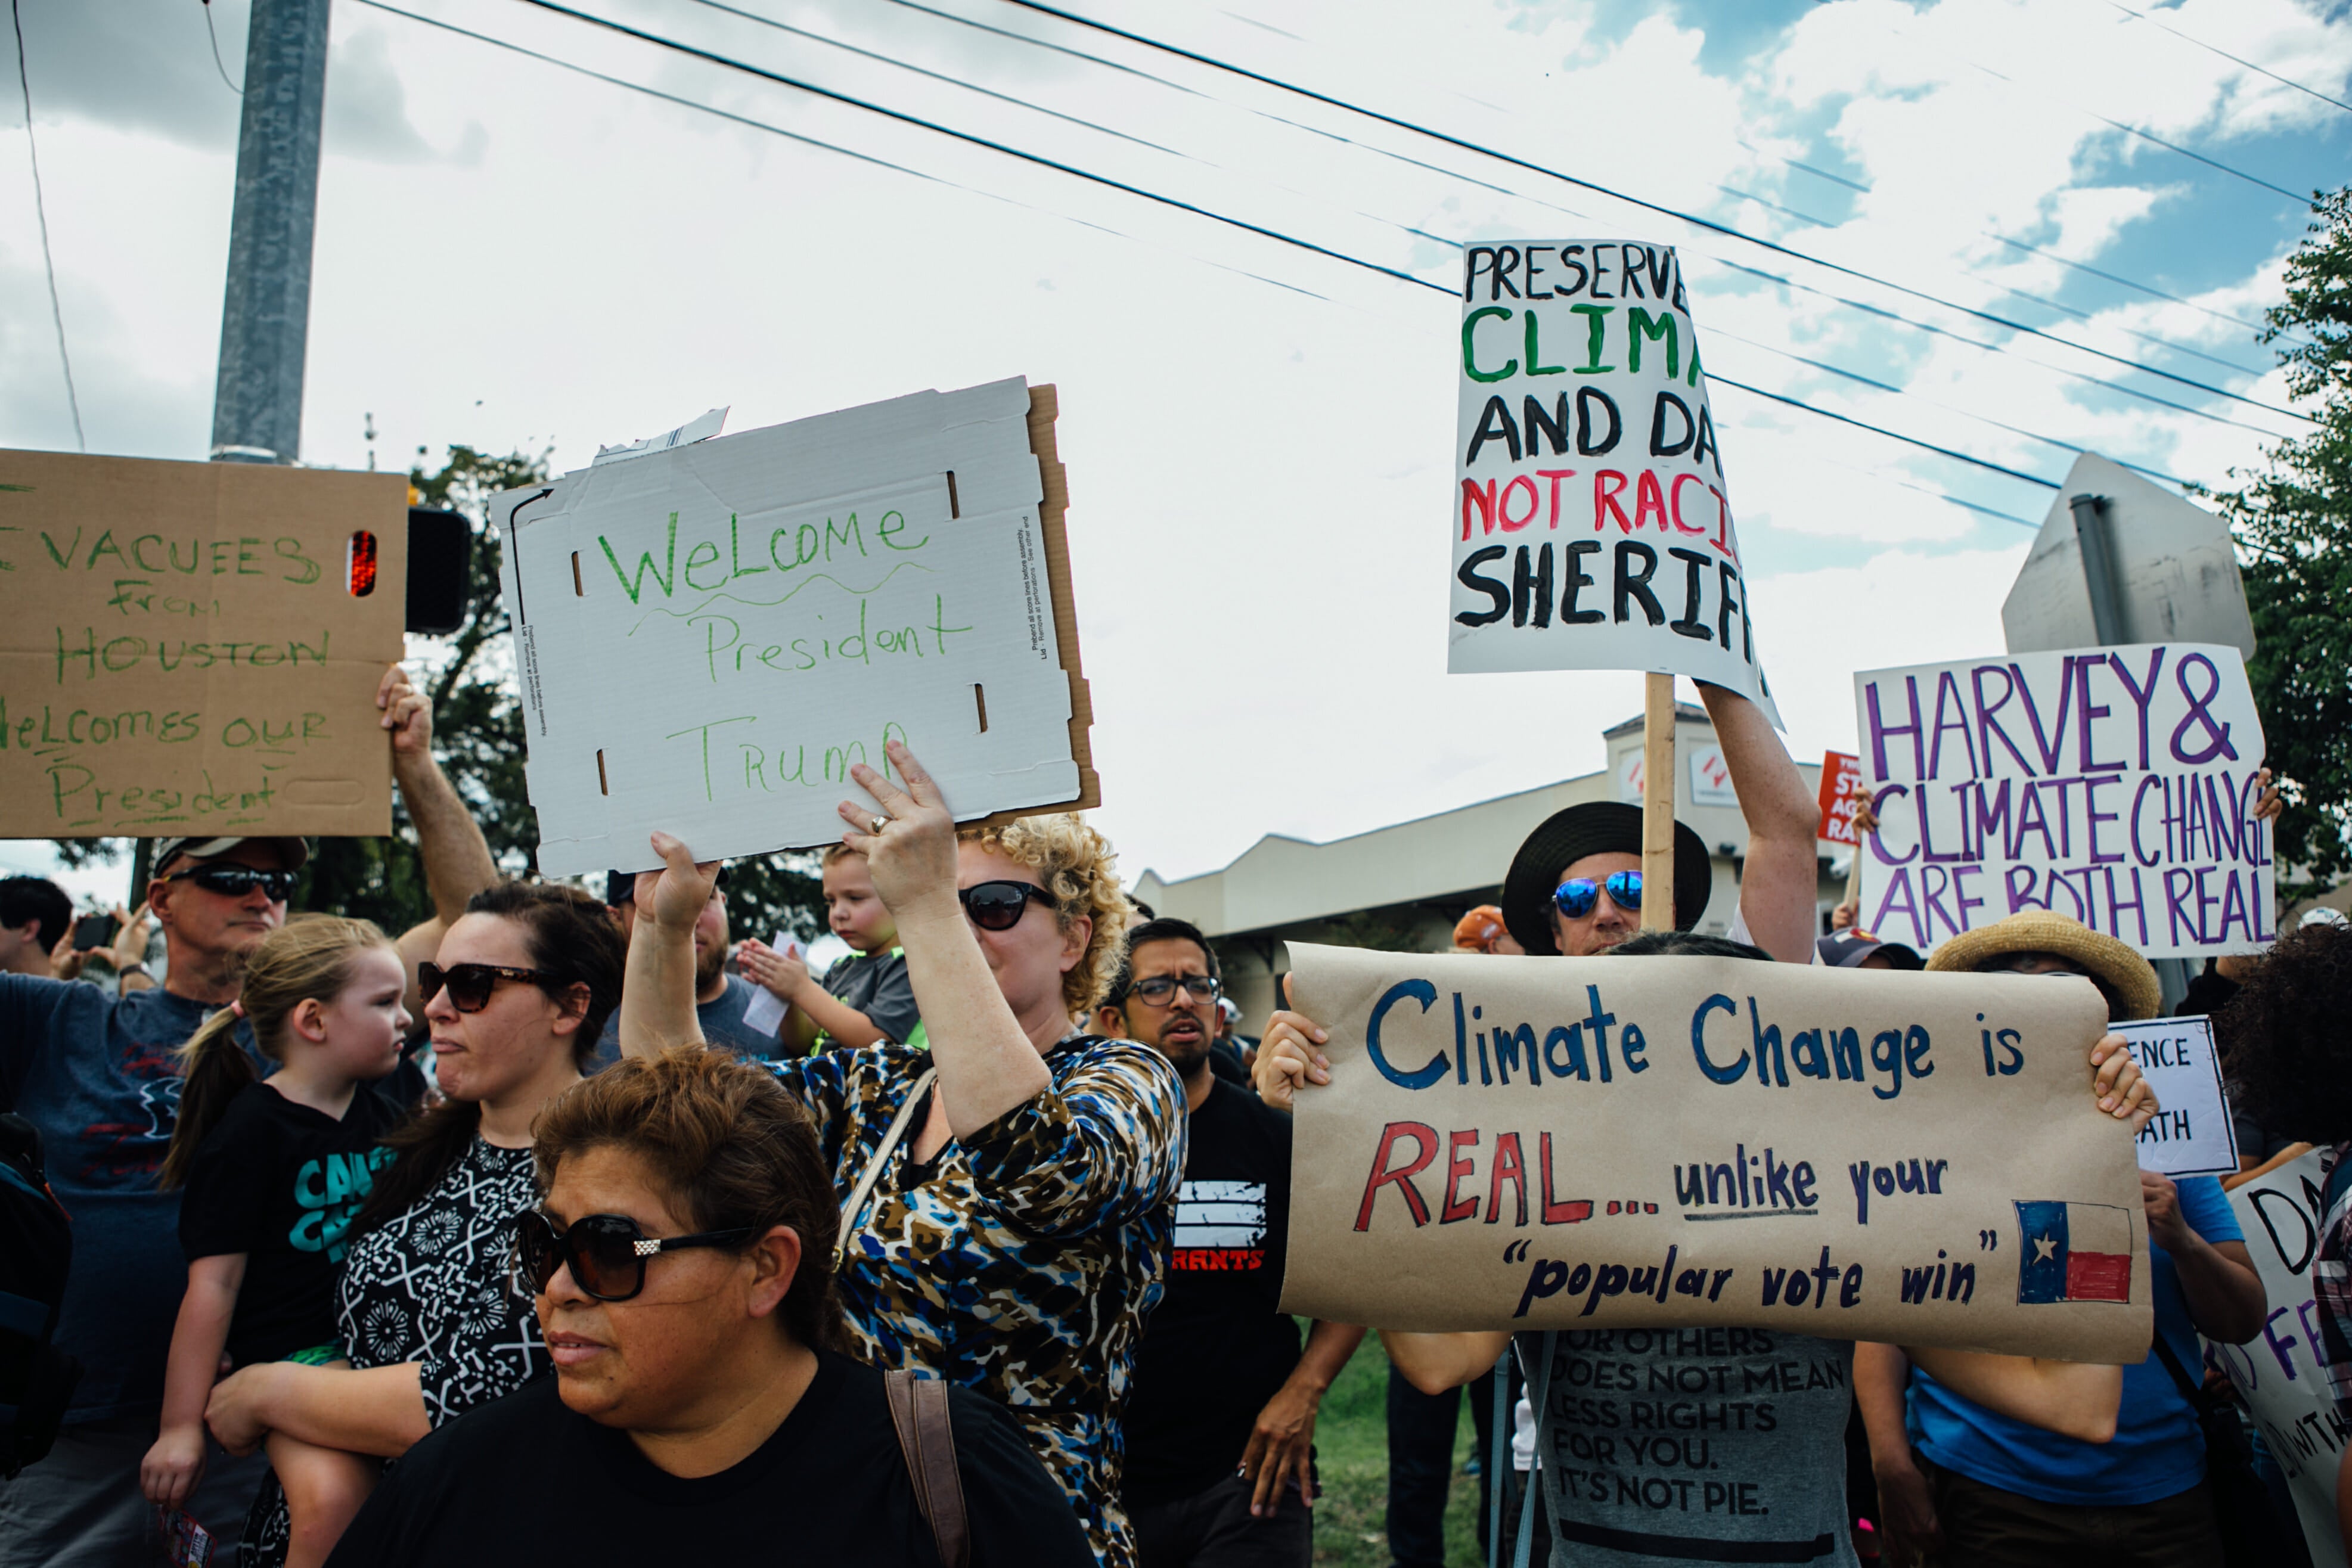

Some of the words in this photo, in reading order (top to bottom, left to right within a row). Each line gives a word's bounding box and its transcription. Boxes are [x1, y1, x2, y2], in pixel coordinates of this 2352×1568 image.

[1467, 386, 1622, 467] AND
[1461, 470, 1577, 541] NOT
[1594, 469, 1742, 570] RACI
[56, 626, 330, 685] HOUSTON
[687, 593, 973, 682] President
[1865, 647, 2166, 782] HARVEY
[2169, 653, 2239, 764] &
[45, 763, 276, 818] President
[1869, 774, 2125, 866] CLIMATE
[1870, 865, 1983, 948] ARE
[2004, 865, 2148, 946] BOTH
[2164, 865, 2276, 947] REAL
[1366, 978, 1649, 1090] Climate
[1692, 993, 1934, 1100] Change
[1976, 1013, 2024, 1076] is
[2136, 1110, 2191, 1143] ATH
[1353, 1120, 1659, 1232] REAL...
[1674, 1143, 1818, 1209] unlike
[1848, 1157, 1948, 1225] your
[1762, 1246, 1863, 1309] vote
[1557, 1330, 1615, 1353] OR
[1623, 1328, 1774, 1356] OTHERS
[1551, 1356, 1637, 1391] DOES
[1649, 1365, 1732, 1395] NOT
[1743, 1360, 1845, 1393] MEAN
[1549, 1390, 1621, 1428] LESS
[1631, 1402, 1777, 1432] RIGHTS
[1554, 1428, 1616, 1464] FOR
[1624, 1437, 1718, 1470] YOU.
[1558, 1467, 1608, 1501] IT'S
[1618, 1475, 1695, 1511] NOT
[1705, 1481, 1768, 1515] PIE.
